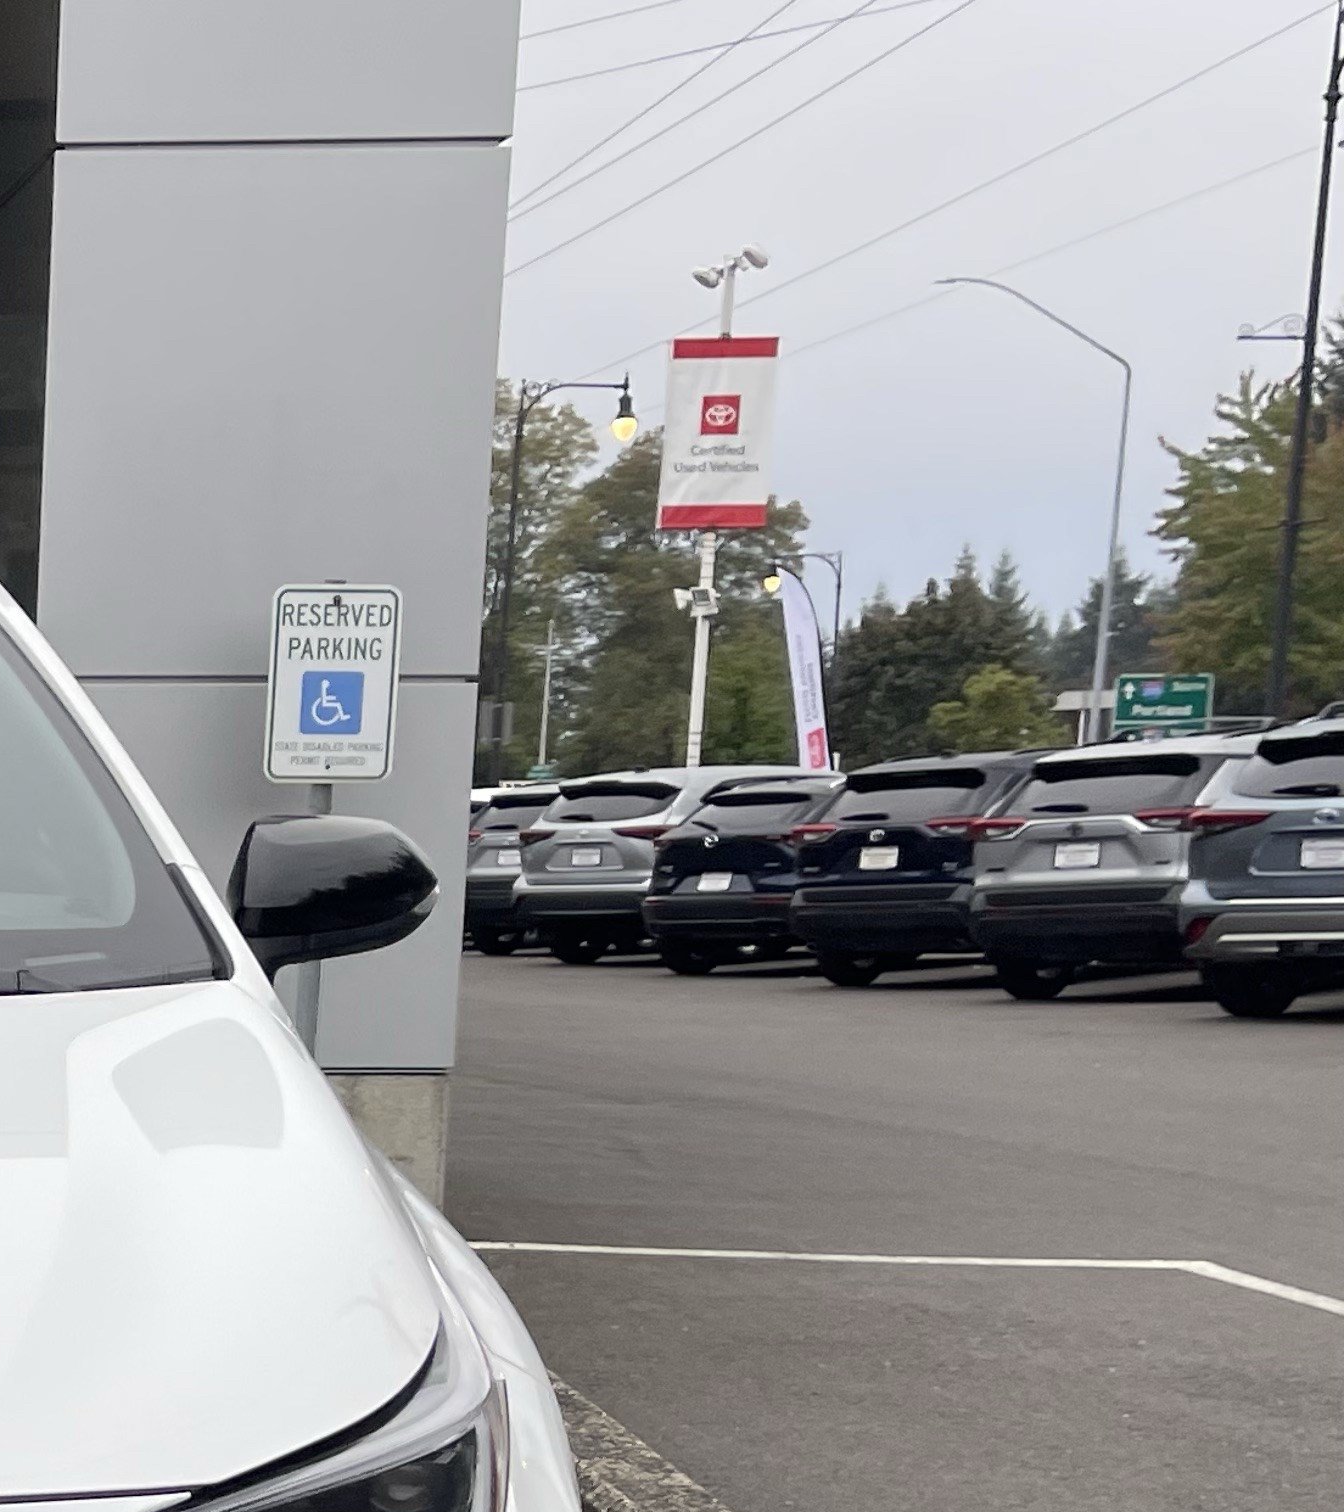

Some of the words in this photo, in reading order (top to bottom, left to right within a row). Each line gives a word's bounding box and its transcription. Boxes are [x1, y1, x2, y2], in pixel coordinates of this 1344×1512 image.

[674, 462, 706, 473] Used
[282, 604, 392, 627] RESERVED
[288, 638, 382, 660] PARKING
